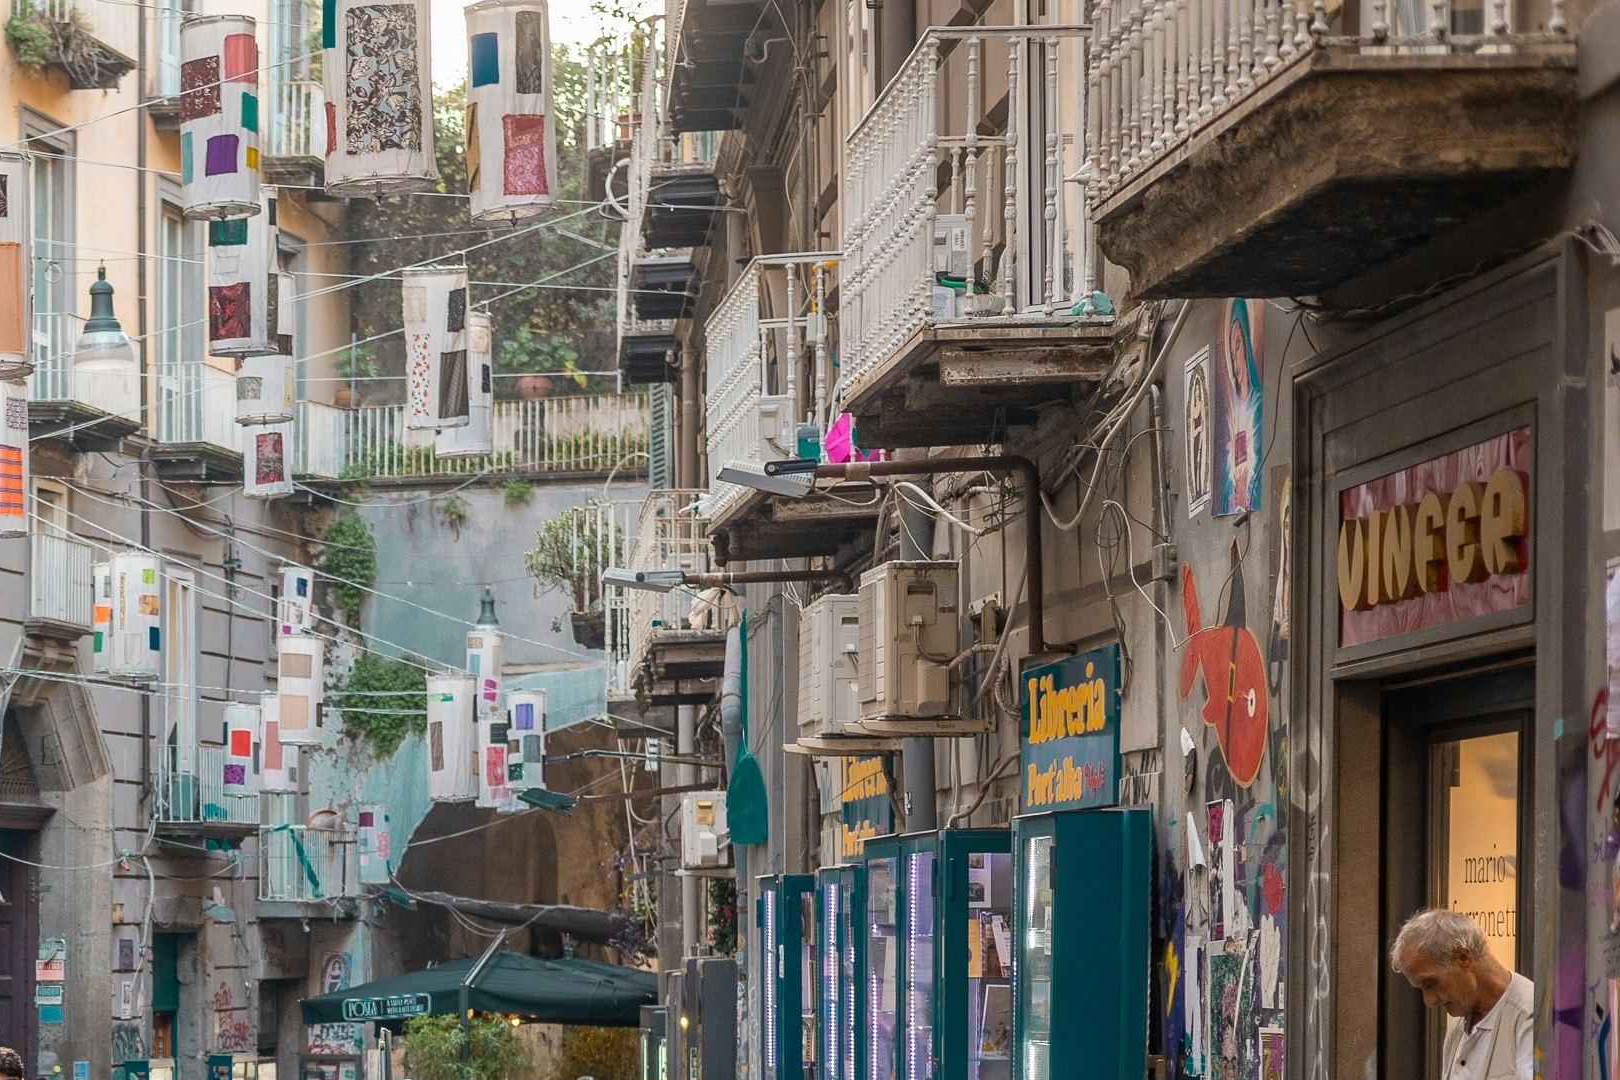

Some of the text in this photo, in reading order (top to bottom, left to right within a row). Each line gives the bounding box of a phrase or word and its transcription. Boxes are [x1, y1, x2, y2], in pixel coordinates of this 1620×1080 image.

[1028, 662, 1107, 744] Libreria
[1027, 756, 1083, 807] Port'alba
[1464, 844, 1506, 883] mario
